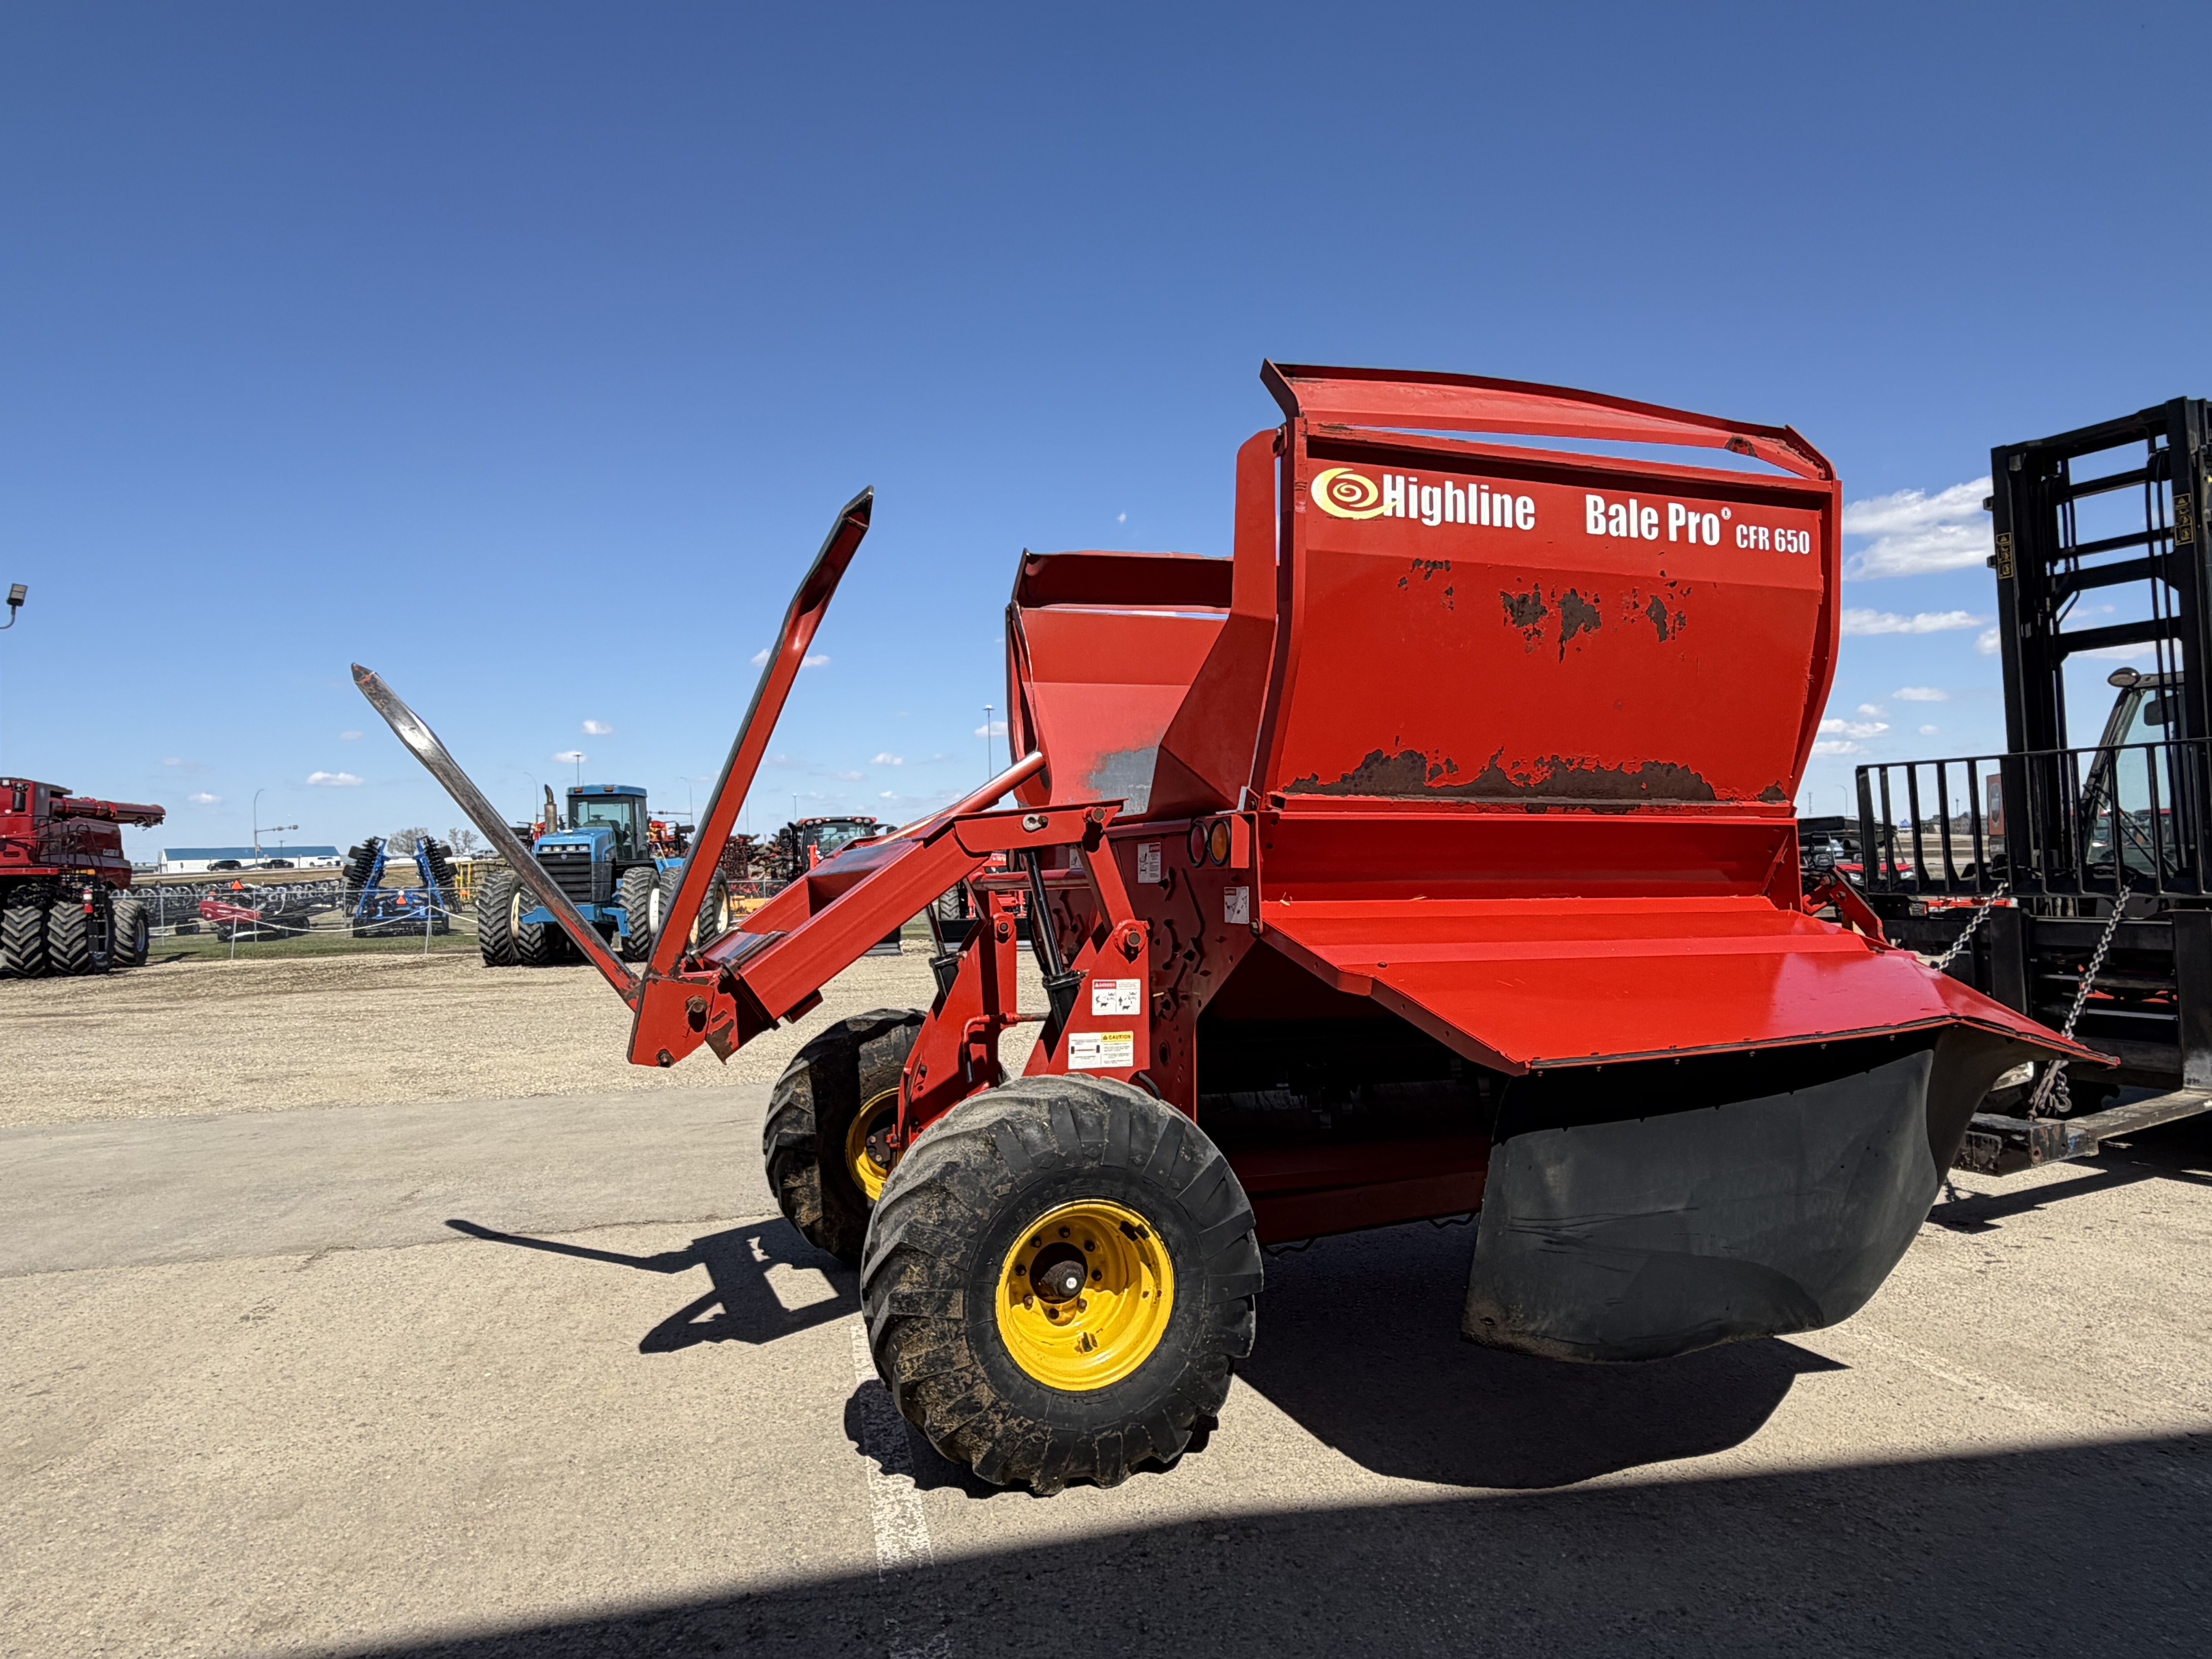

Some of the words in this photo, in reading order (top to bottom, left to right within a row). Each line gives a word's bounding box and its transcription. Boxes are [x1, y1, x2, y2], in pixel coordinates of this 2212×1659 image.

[1383, 474, 1535, 530] Highline
[1586, 495, 1659, 541] Bale
[1736, 524, 1770, 551] CFR
[1775, 528, 1810, 555] 650
